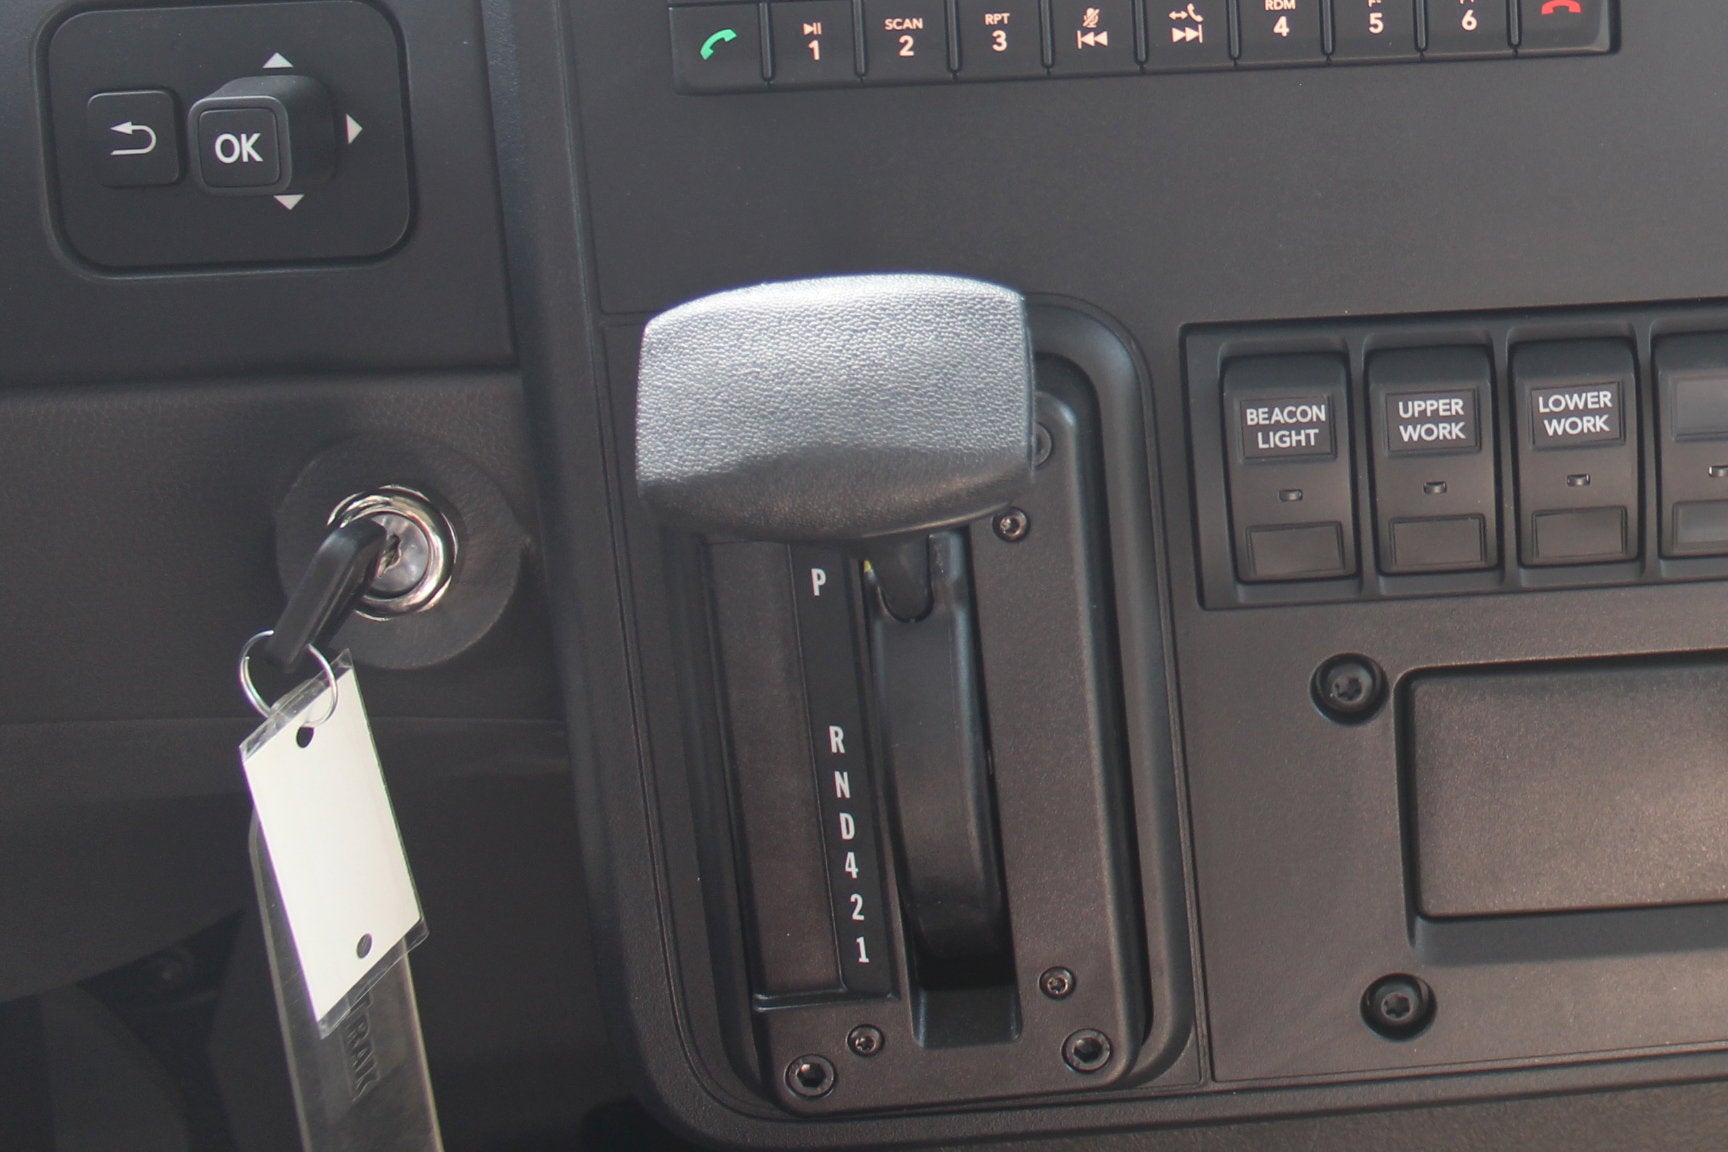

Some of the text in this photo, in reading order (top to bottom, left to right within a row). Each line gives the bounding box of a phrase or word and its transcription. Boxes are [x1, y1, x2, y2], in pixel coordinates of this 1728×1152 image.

[885, 17, 923, 31] SCAN
[984, 12, 1010, 26] RPT
[1273, 16, 1290, 37] 4
[1369, 13, 1384, 34] 5
[1461, 9, 1477, 31] 6
[808, 40, 821, 61] 1
[899, 35, 915, 57] 2
[992, 31, 1007, 52] 3
[215, 132, 264, 164] OK
[1398, 399, 1464, 419] UPPER
[1538, 391, 1613, 413] LOWER
[1246, 404, 1326, 425] BEACON
[1399, 422, 1466, 442] WORK
[1544, 415, 1610, 436] WORK
[1257, 429, 1319, 448] LIGHT
[811, 568, 827, 597] P
[829, 725, 846, 754] R
[834, 771, 850, 799] N
[840, 812, 856, 841] D
[845, 852, 859, 879] 4
[850, 894, 865, 921] 2
[856, 937, 870, 964] 1
